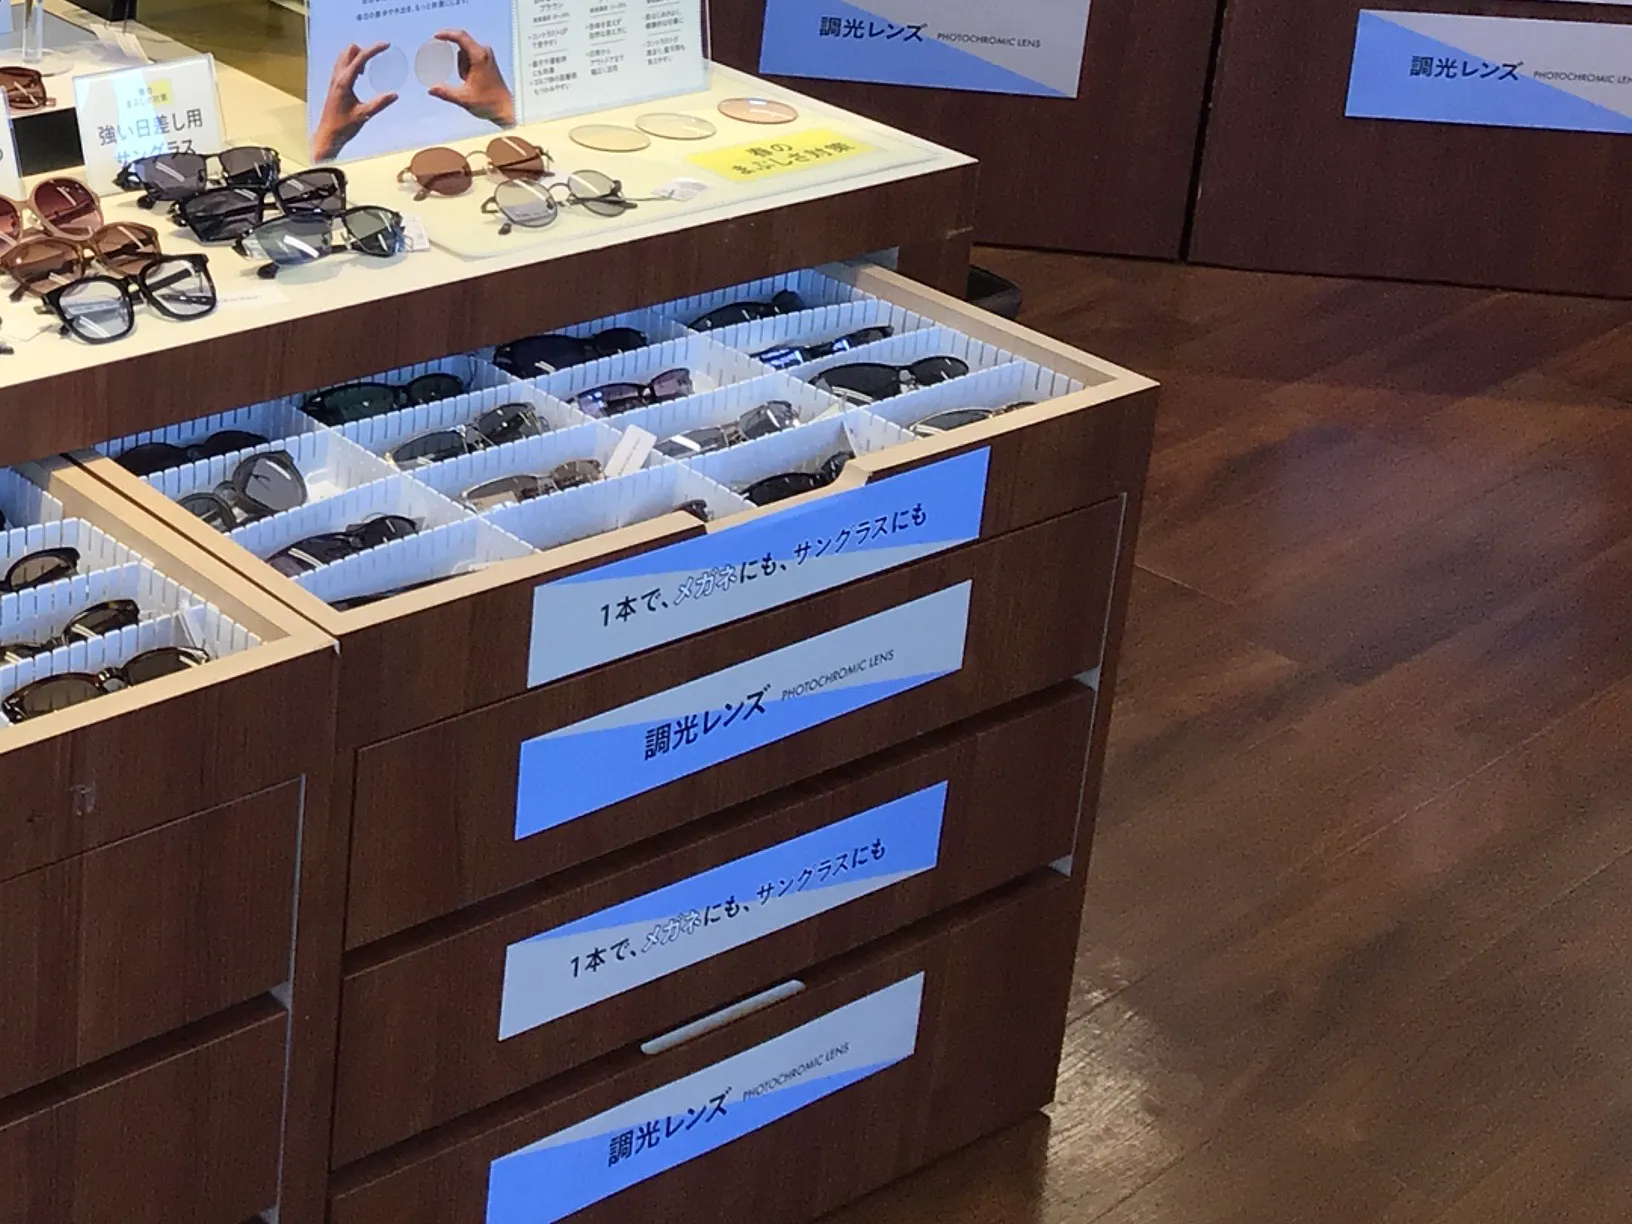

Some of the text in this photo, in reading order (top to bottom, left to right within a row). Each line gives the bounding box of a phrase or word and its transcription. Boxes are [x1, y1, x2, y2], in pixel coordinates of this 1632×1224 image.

[819, 15, 1042, 49] 調光レンズ PHOTOCHROMIC LENS
[1410, 55, 1525, 82] 調光レンズ
[1533, 69, 1615, 84] PHOTOCHROMIC
[97, 108, 203, 147] 強い日差し用
[732, 142, 856, 175] まぶしさ対策
[746, 142, 793, 157] 春の
[644, 649, 895, 761] 調光レンズ PHOTOCHROMIC LENS
[607, 1041, 851, 1168] 調光レンズ PHOTOCHROMIC LENS
